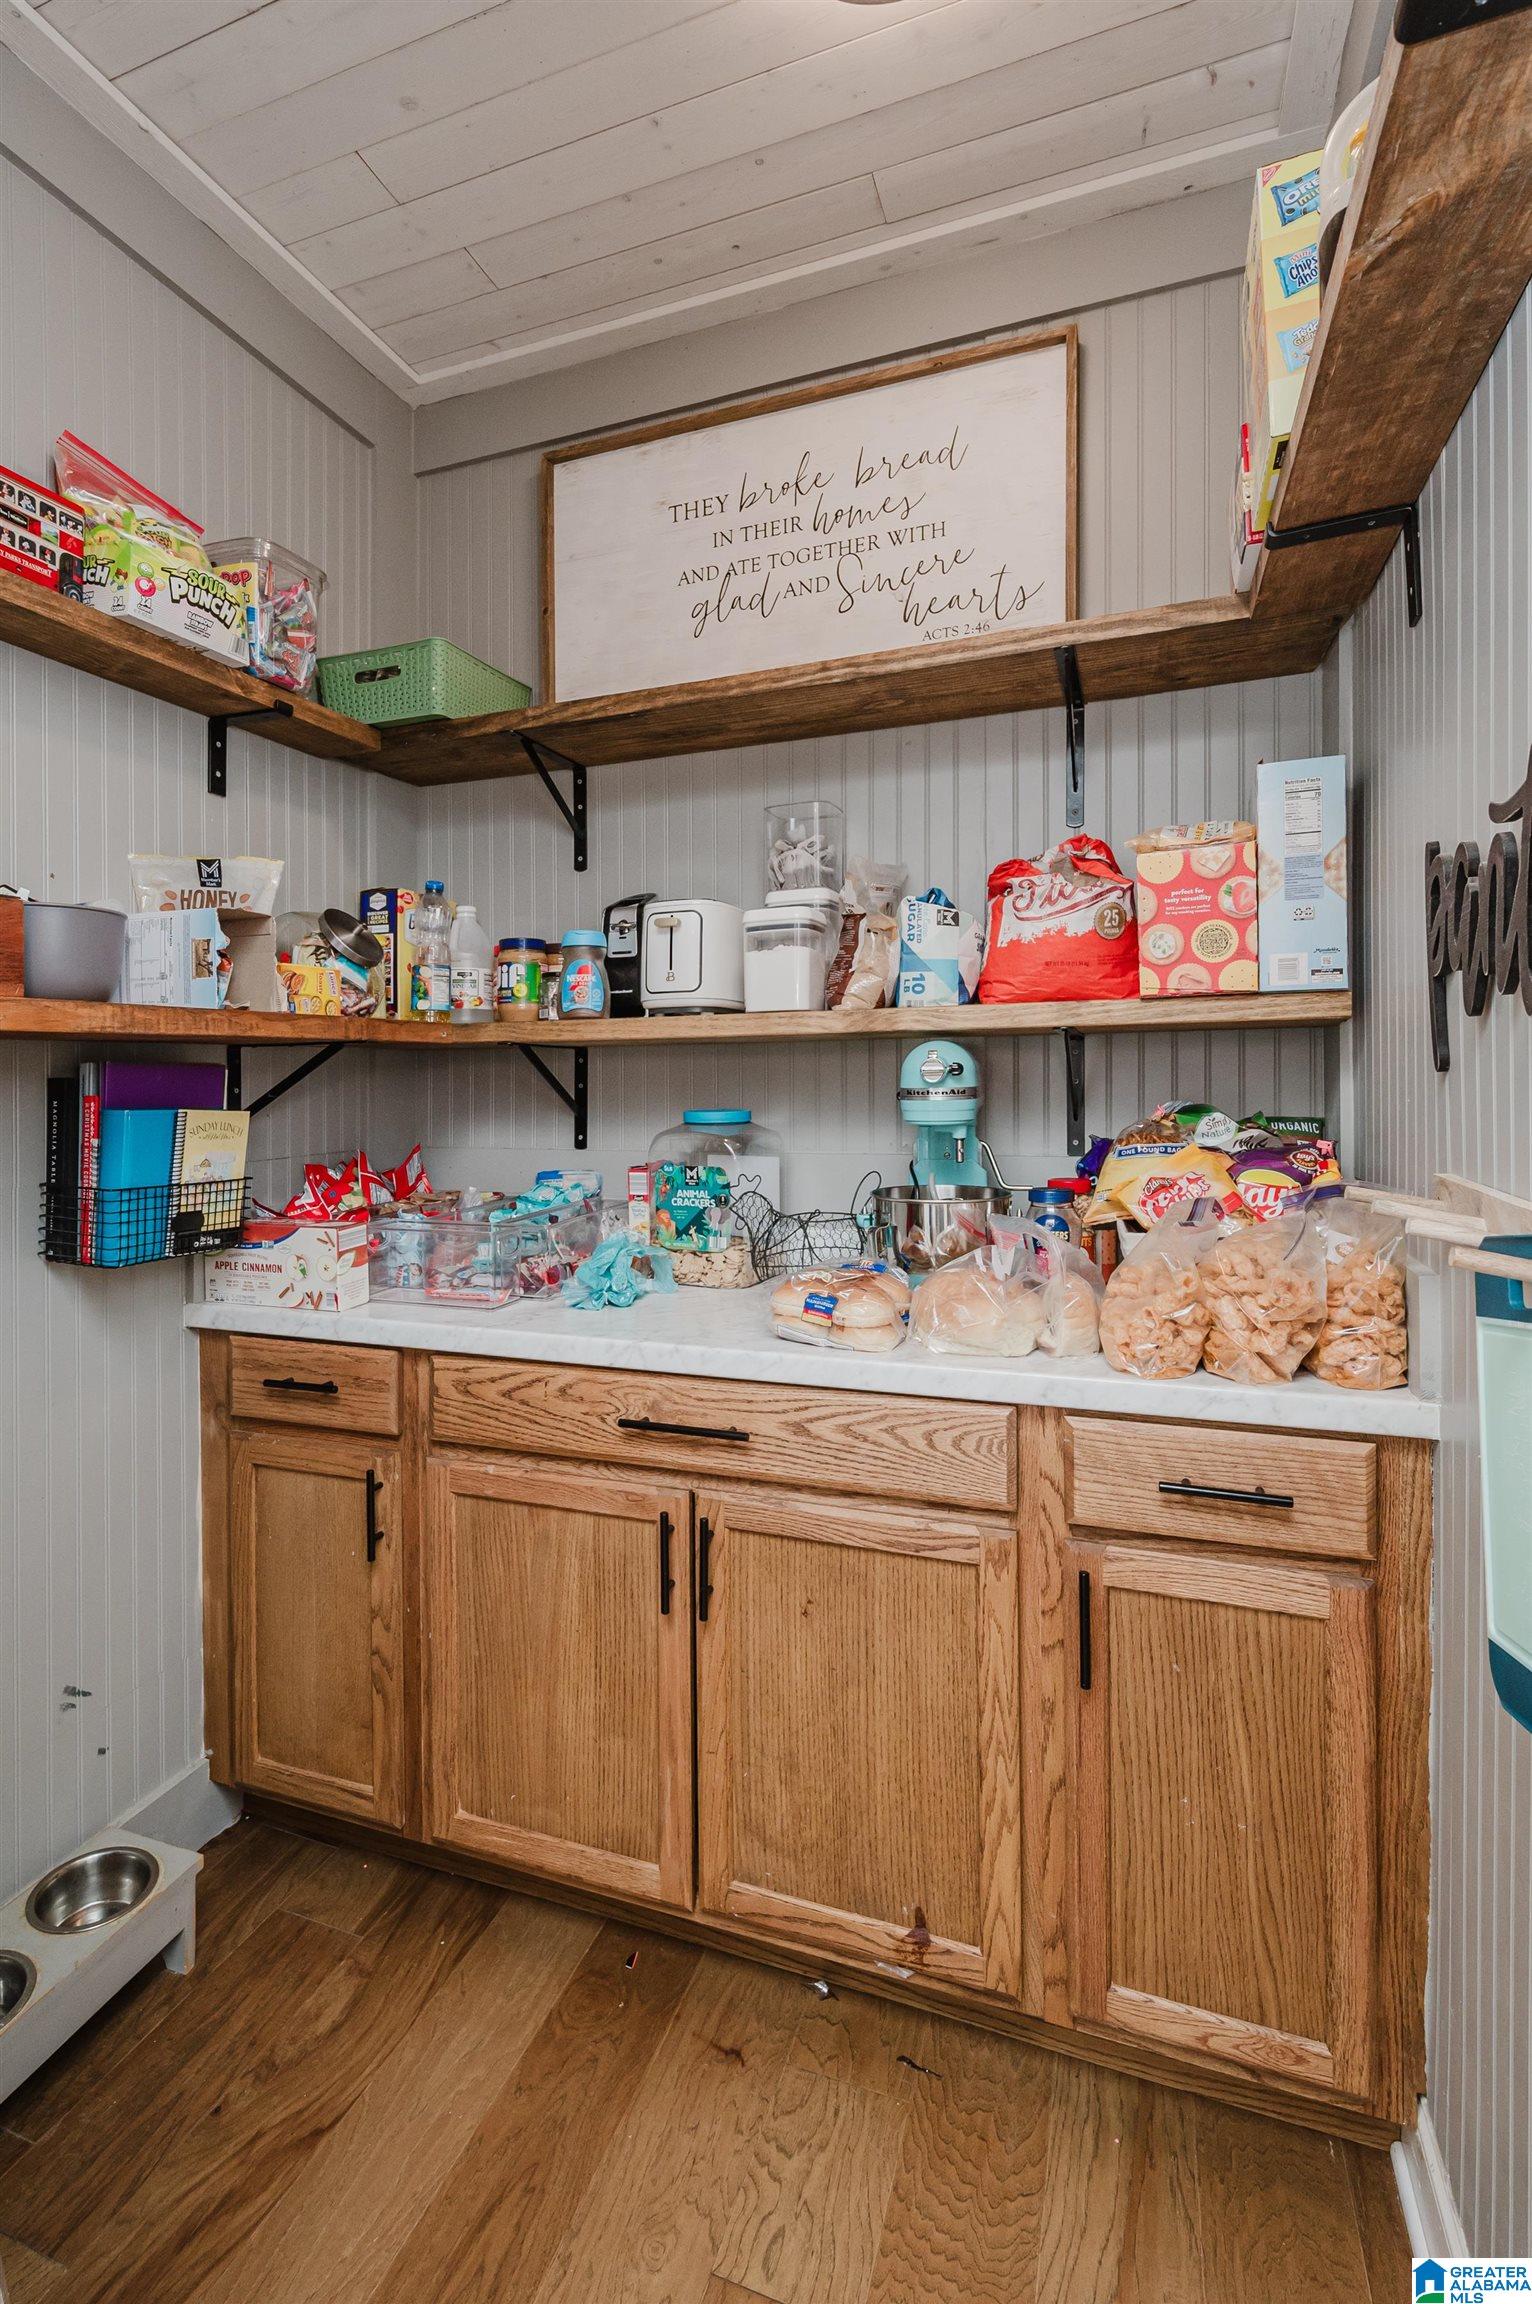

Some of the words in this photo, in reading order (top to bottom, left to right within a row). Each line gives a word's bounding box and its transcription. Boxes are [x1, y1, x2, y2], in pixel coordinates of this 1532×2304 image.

[1283, 178, 1320, 205] ORE
[1289, 255, 1318, 280] Chips
[1292, 320, 1319, 339] Ted
[668, 494, 730, 523] THEY
[739, 451, 835, 512] broke
[855, 425, 969, 488] bread
[712, 529, 733, 548] IN
[740, 516, 803, 542] THEIR
[813, 492, 926, 535] homes
[677, 565, 719, 587] AND
[727, 557, 762, 577] ATE
[767, 534, 880, 569] TOGETHER
[887, 521, 946, 546] WITH
[188, 569, 226, 597] SOUR
[169, 576, 238, 629] PUNCH
[691, 571, 780, 638] glad
[783, 576, 830, 599] AND
[903, 564, 1045, 626] hearts
[922, 625, 959, 641] ACTS
[964, 620, 990, 635] 2:46
[181, 889, 237, 910] HONEY
[1171, 889, 1193, 897] perfect
[1181, 894, 1211, 902] versatility
[1103, 908, 1119, 927] 25
[903, 979, 911, 993] LB
[911, 973, 926, 994] 10
[906, 1088, 967, 1096] KitchenAid
[189, 1121, 218, 1135] SUNDAY
[220, 1121, 243, 1136] LUNCH
[1201, 1126, 1232, 1139] Nature
[1271, 1121, 1320, 1134] ORGANIC
[1121, 1148, 1136, 1156] ONE
[1137, 1146, 1165, 1155] POUND
[671, 1198, 716, 1209] CRACKERS
[676, 1189, 710, 1198] ANIMAL
[1238, 1183, 1298, 1219] Lay
[215, 1261, 238, 1271] APPLE
[242, 1263, 282, 1273] CINNAMON
